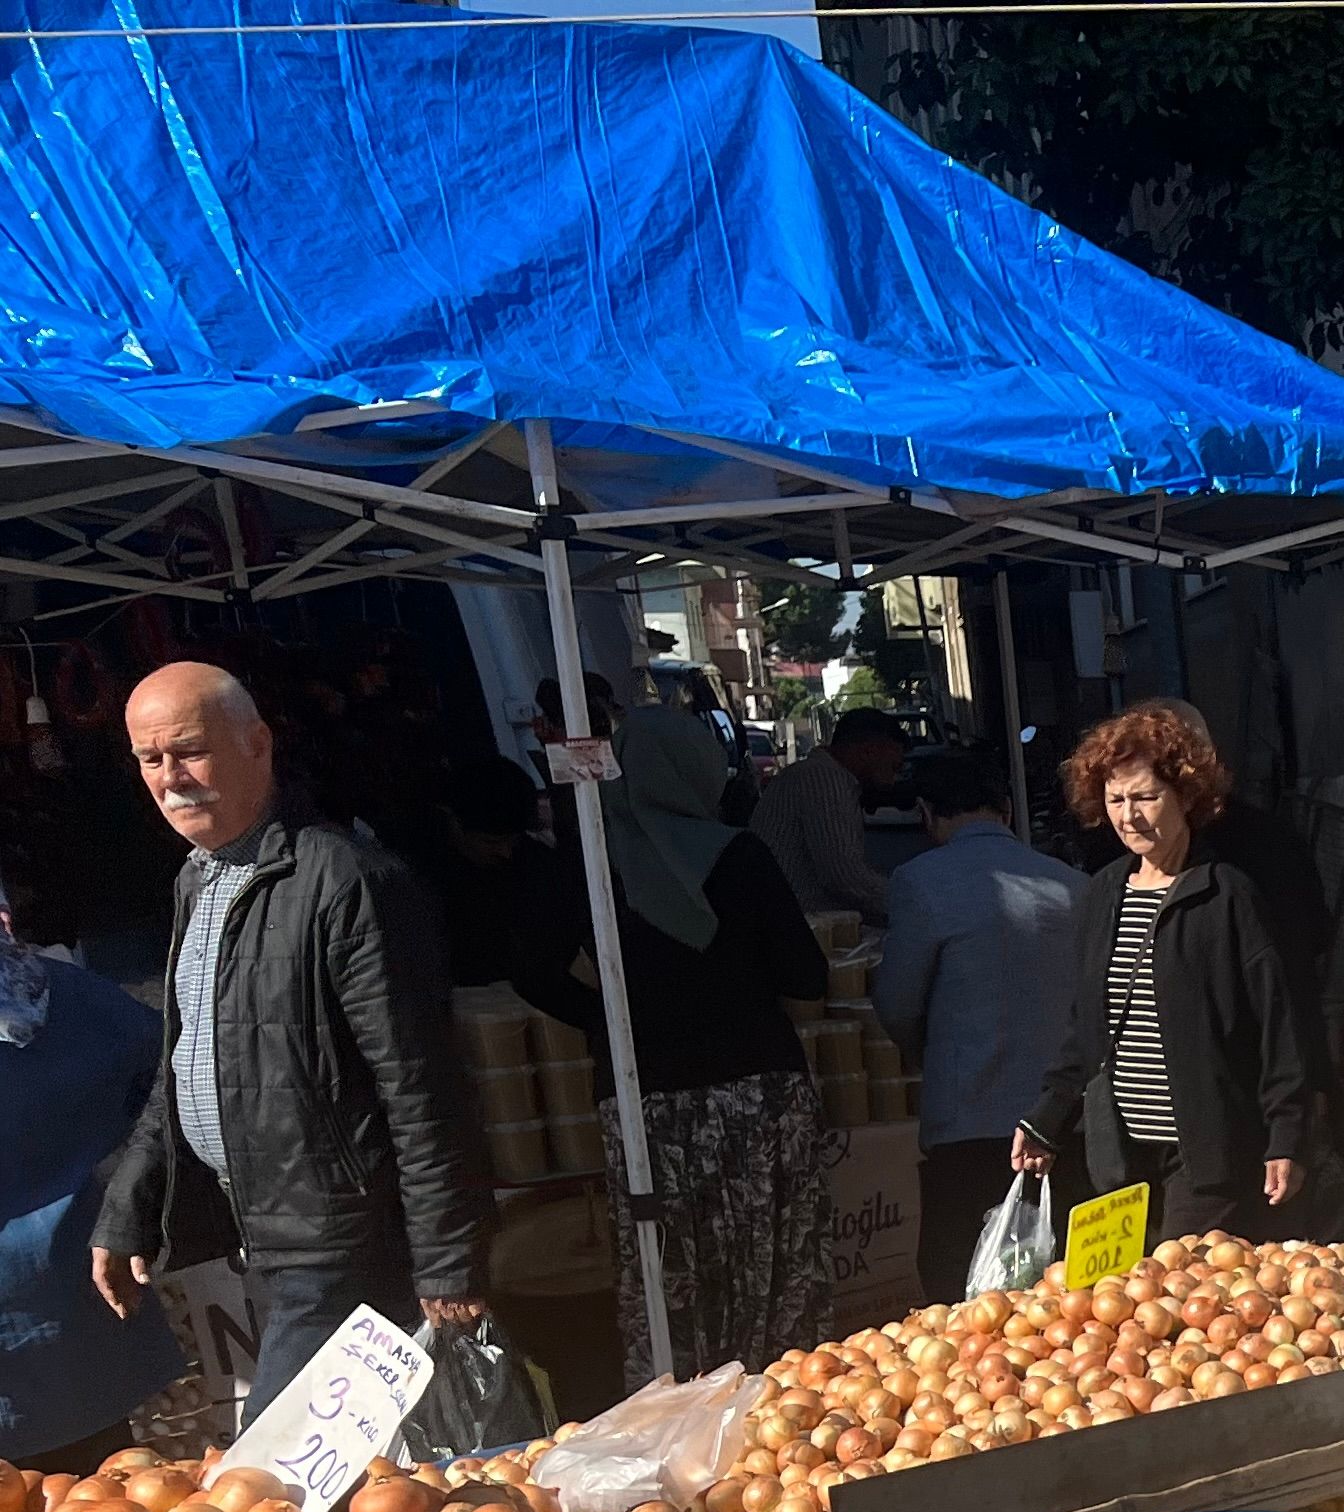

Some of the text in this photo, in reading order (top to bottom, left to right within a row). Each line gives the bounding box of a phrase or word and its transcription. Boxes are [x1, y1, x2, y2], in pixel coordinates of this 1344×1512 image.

[832, 1250, 870, 1281] DA
[351, 1317, 422, 1374] AMASYA
[274, 1433, 350, 1500] 200
